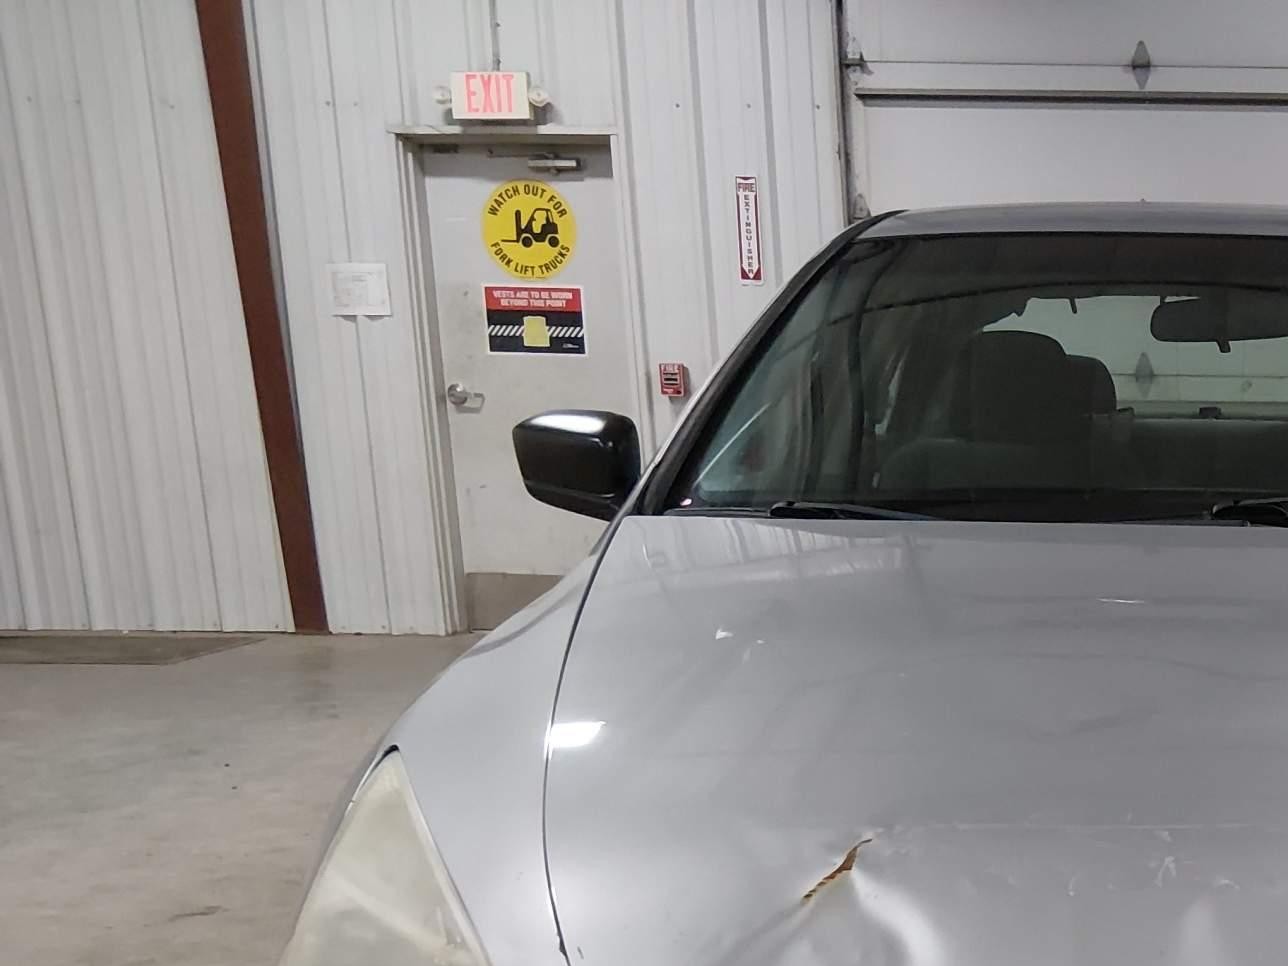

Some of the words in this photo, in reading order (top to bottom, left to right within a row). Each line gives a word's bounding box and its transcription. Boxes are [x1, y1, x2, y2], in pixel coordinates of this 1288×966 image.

[465, 74, 514, 112] EXIT
[488, 185, 521, 216] WATCH
[523, 184, 547, 198] OUT
[547, 195, 568, 218] FOR
[738, 183, 755, 192] FIRE
[743, 194, 754, 274] EXTINGUISHER
[490, 241, 514, 268] FORK
[514, 263, 536, 276] LIFT
[538, 244, 570, 275] TRUCKS
[530, 291, 540, 299] TO
